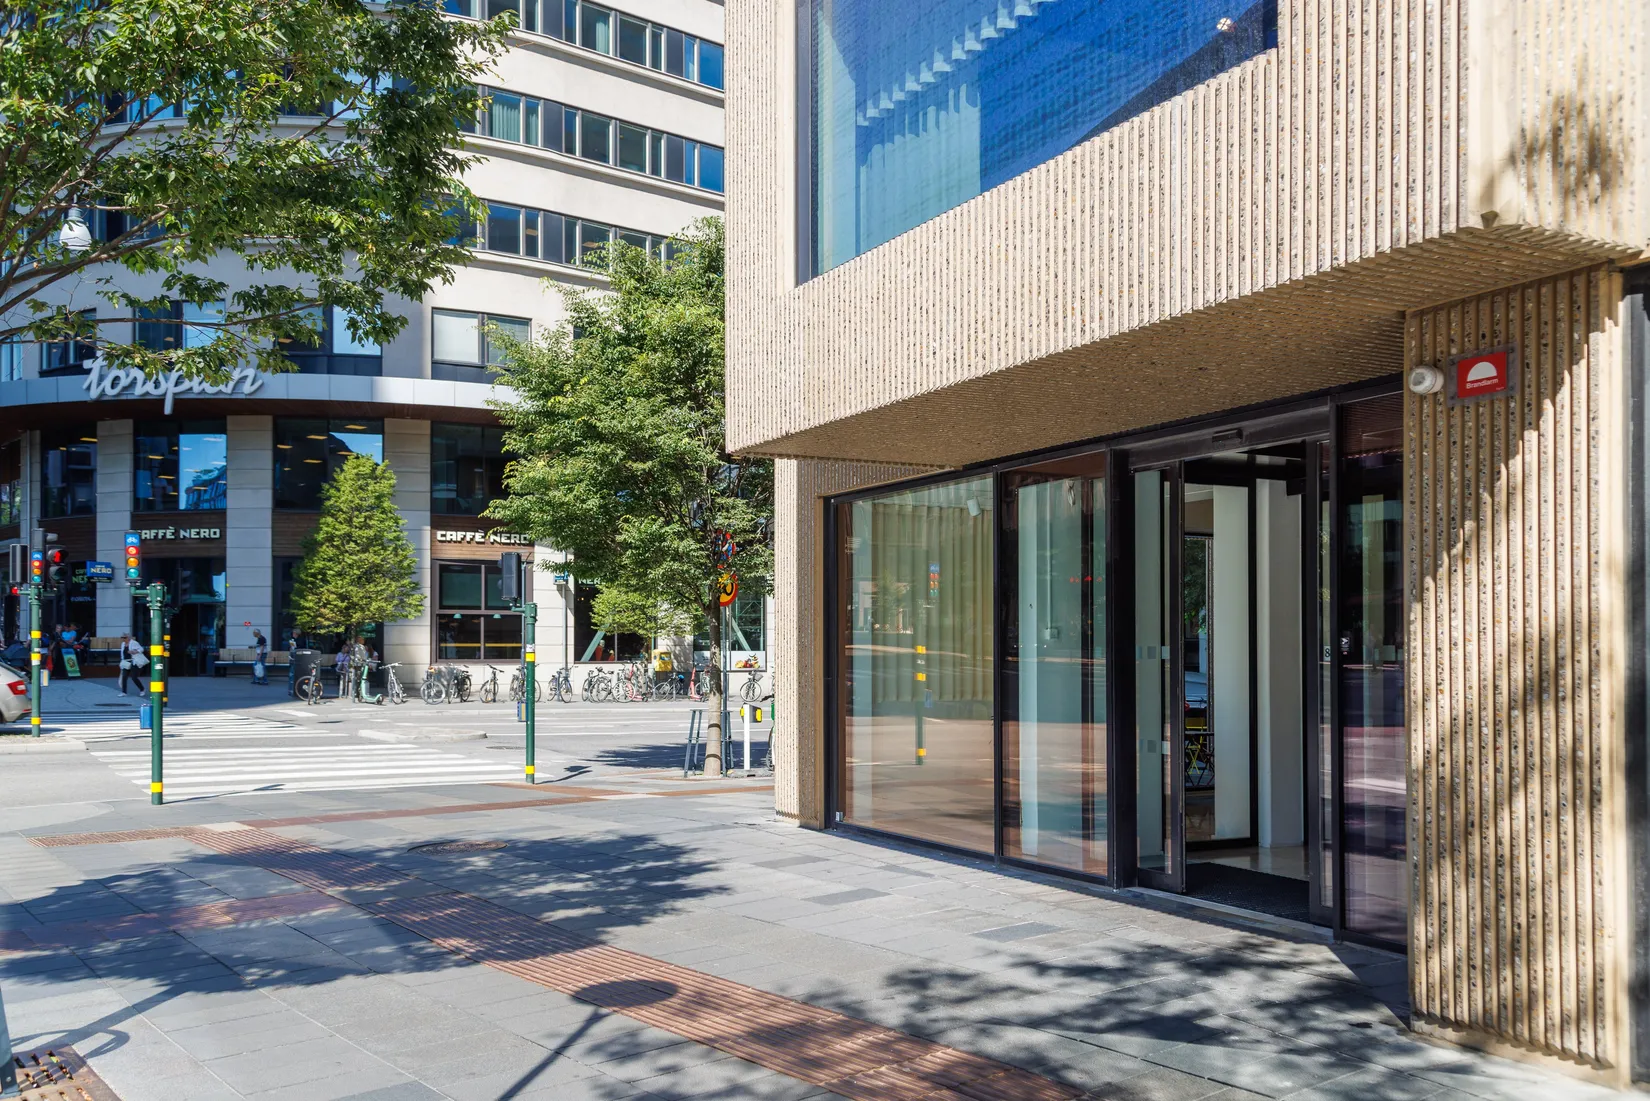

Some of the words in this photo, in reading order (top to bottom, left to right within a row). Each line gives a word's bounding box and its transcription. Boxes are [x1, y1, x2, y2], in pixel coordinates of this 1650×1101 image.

[138, 526, 175, 540] AFFÈ
[180, 528, 220, 539] NERO
[437, 529, 485, 543] CAFFÈ
[1324, 647, 1331, 658] 8
